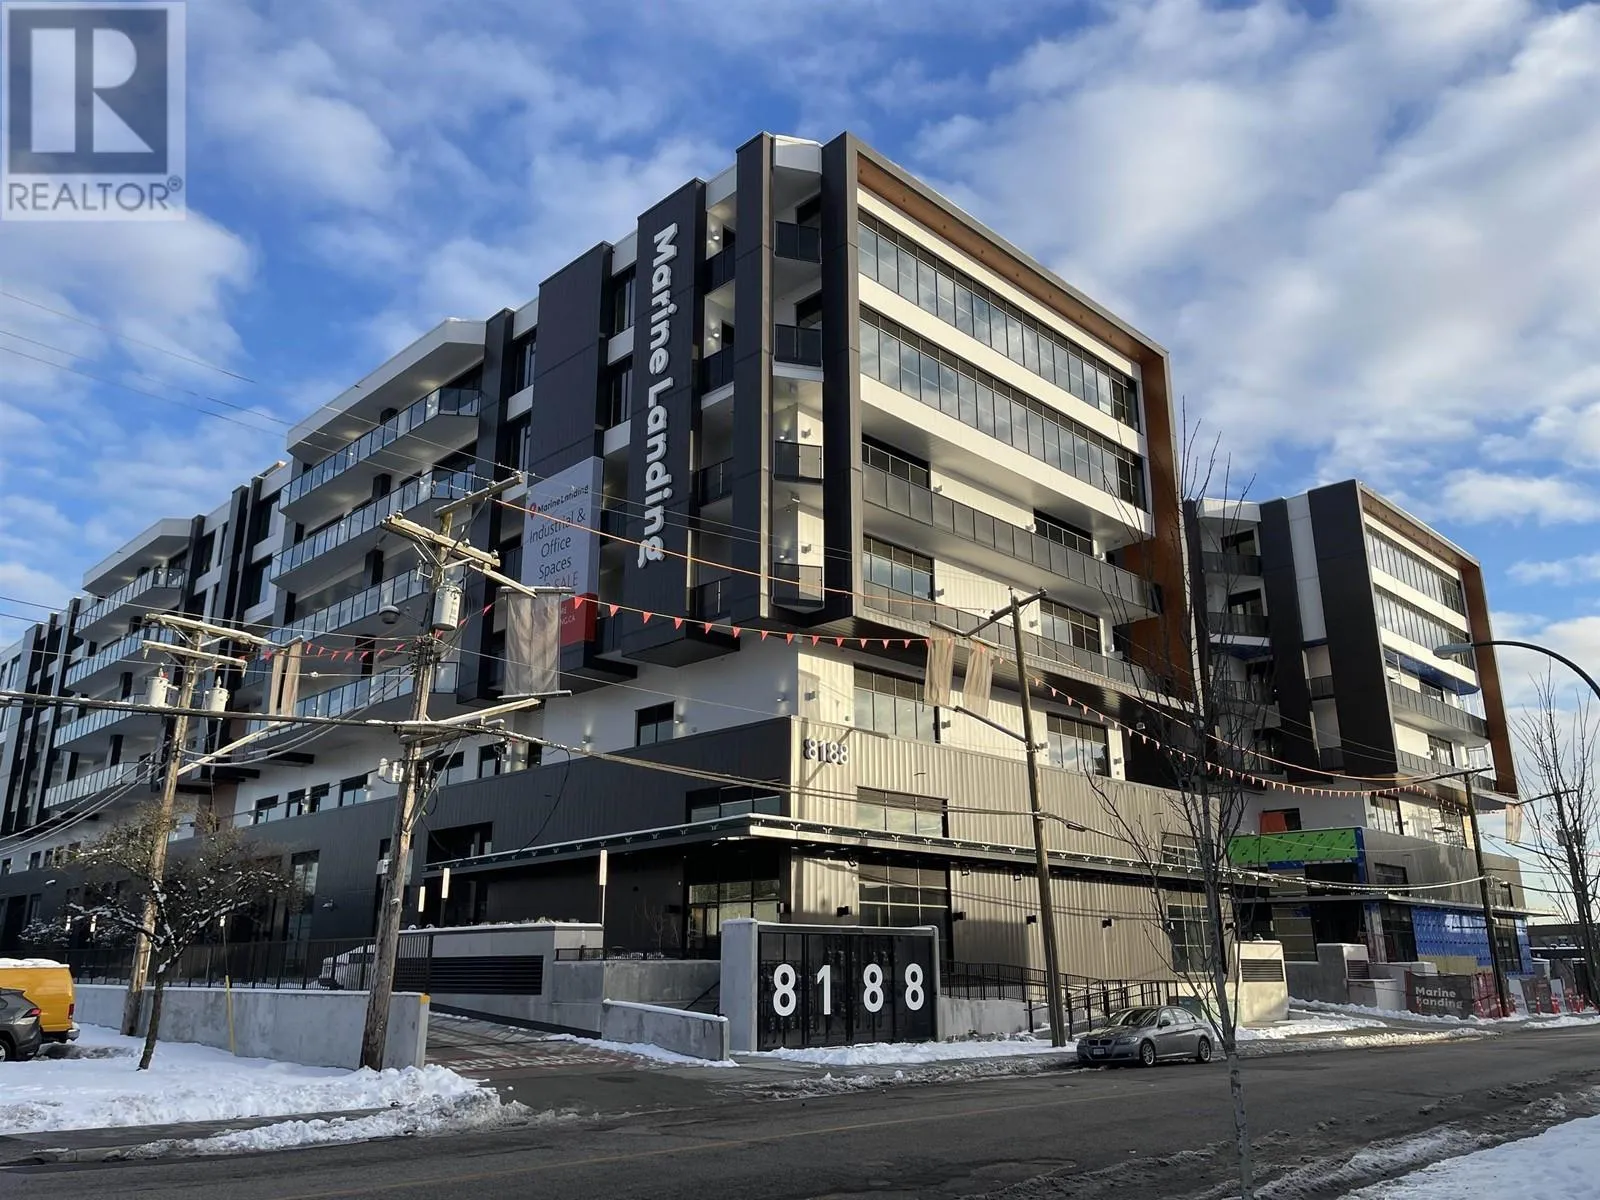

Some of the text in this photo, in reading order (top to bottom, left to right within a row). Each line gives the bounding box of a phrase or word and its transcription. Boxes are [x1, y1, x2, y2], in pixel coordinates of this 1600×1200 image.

[638, 222, 678, 569] Marine Landing
[529, 507, 586, 545] Industrial &
[540, 536, 572, 558] Office
[538, 556, 572, 581] Spaces
[803, 738, 849, 766] 8188
[773, 963, 925, 1017] 8188
[1415, 986, 1457, 998] Marine
